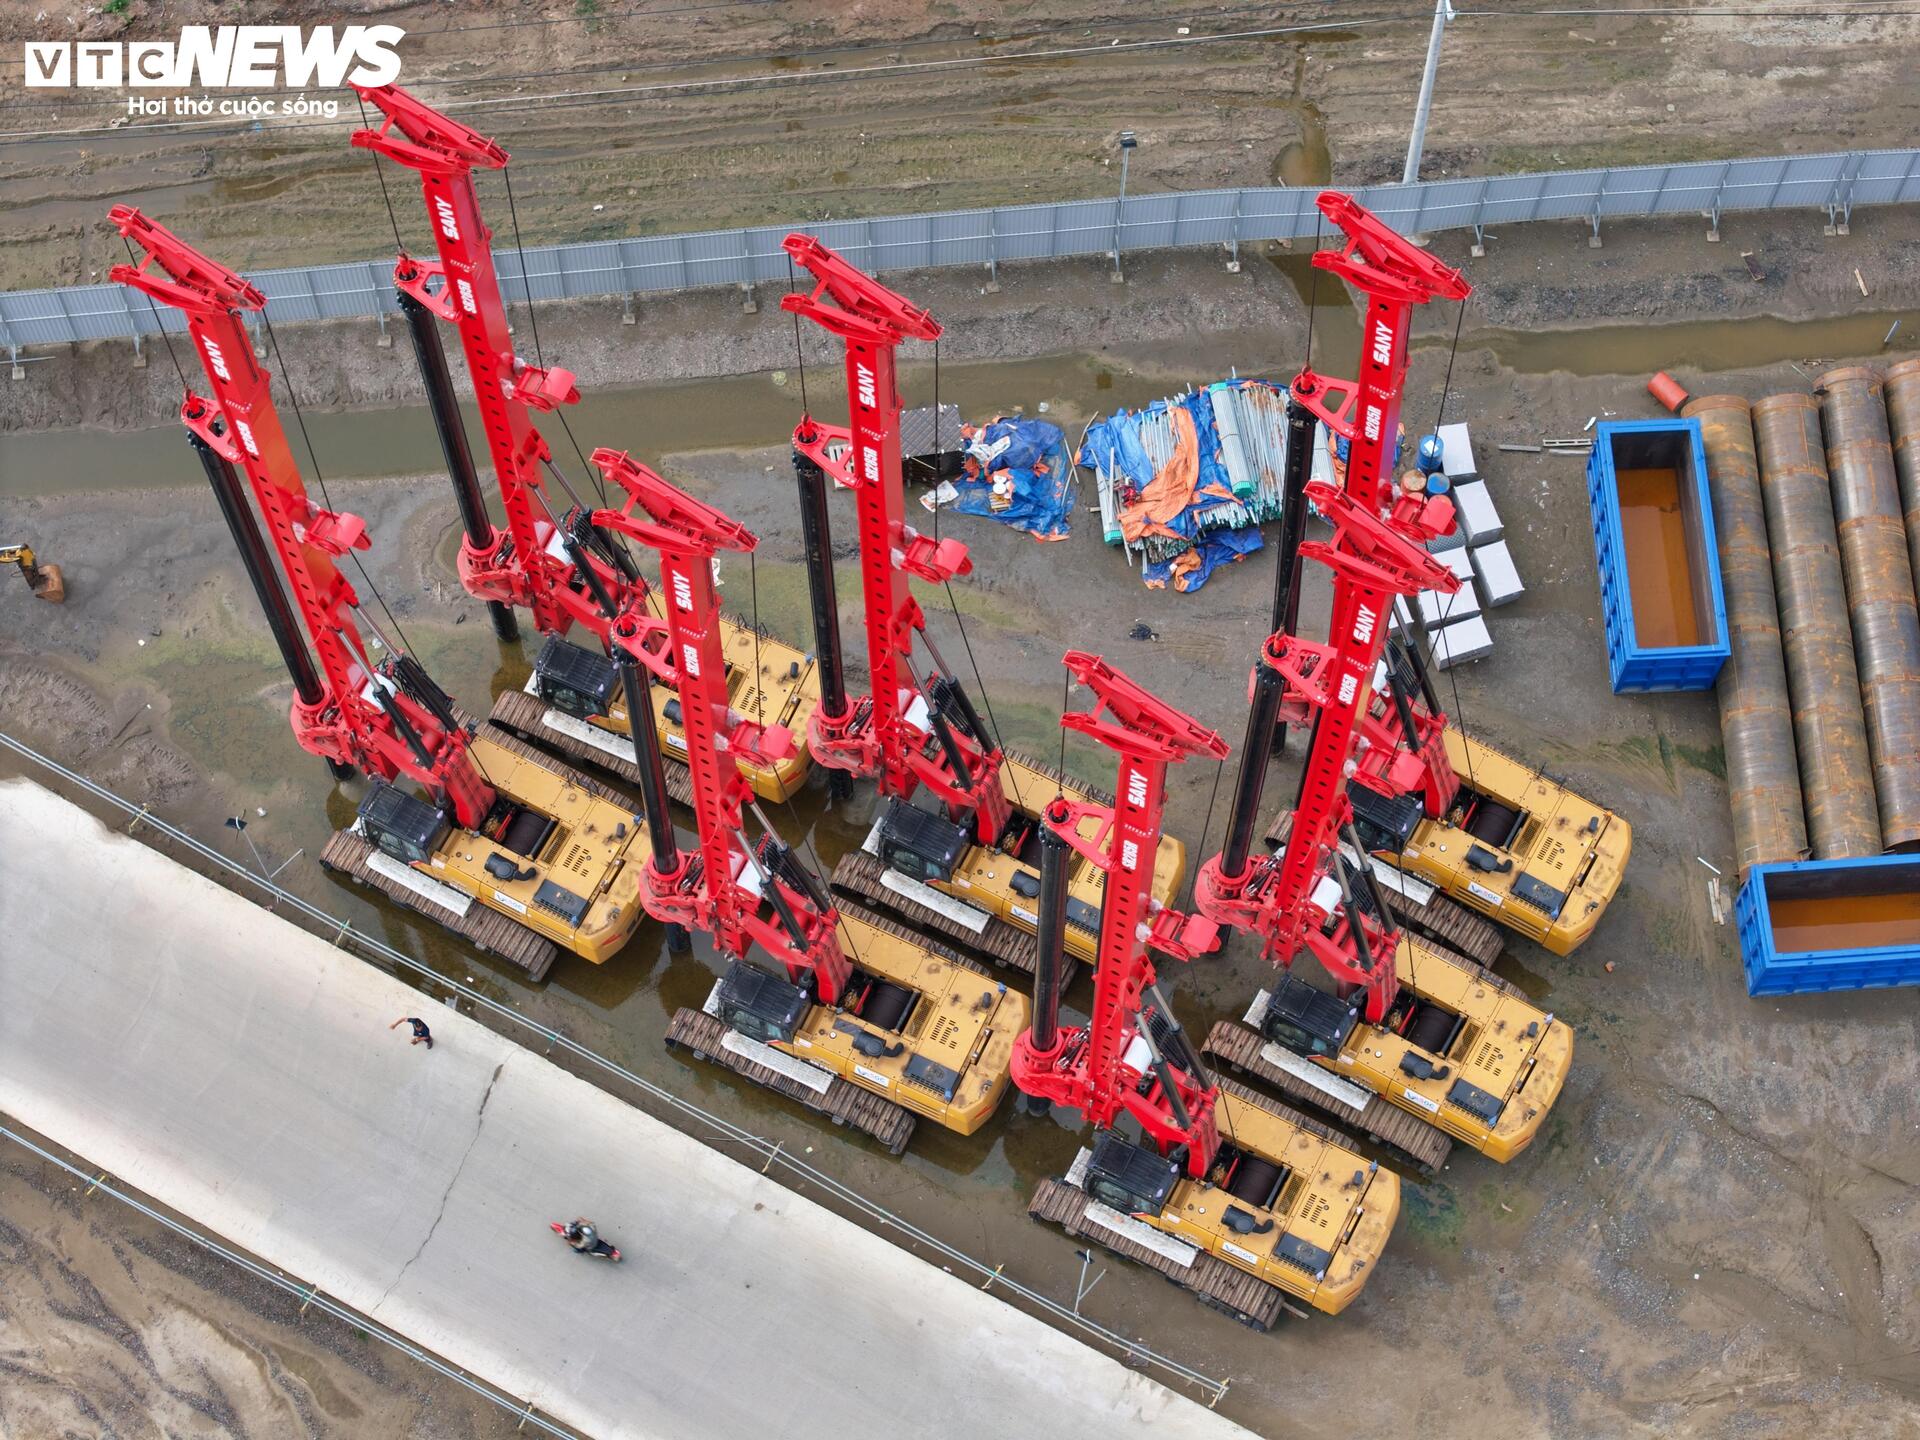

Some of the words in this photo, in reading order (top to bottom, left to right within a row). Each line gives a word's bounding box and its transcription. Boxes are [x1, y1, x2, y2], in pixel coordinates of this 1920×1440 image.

[434, 195, 459, 240] SANY
[201, 334, 231, 381] SANY
[1373, 319, 1393, 366] SANY
[857, 362, 876, 408] SANY
[672, 569, 693, 611] SANY
[1353, 603, 1376, 645] SANY
[1127, 768, 1149, 809] SANY
